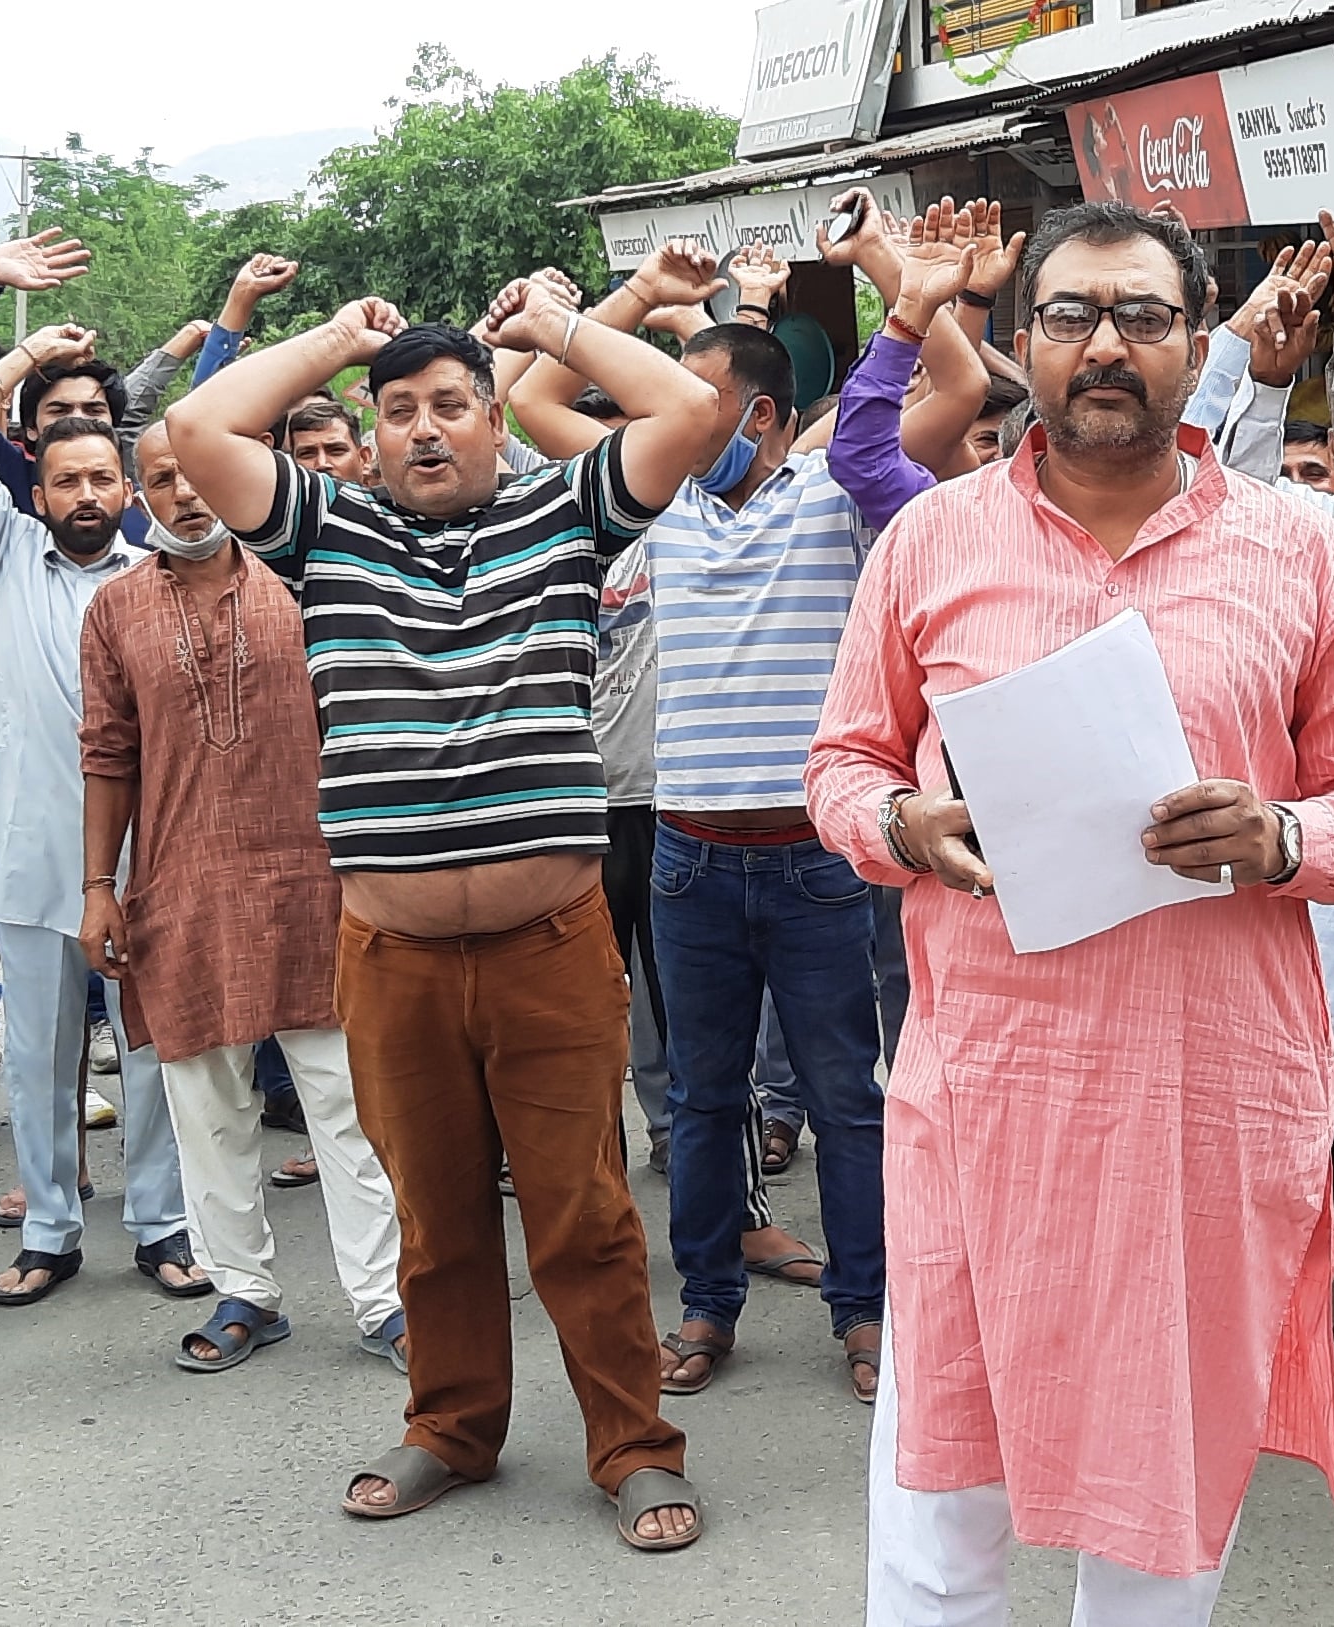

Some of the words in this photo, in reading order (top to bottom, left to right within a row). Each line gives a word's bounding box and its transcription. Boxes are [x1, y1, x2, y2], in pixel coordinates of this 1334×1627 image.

[756, 41, 839, 91] VIDEOCON
[1238, 105, 1282, 140] RANYAL
[1140, 115, 1210, 193] Coca-Cola
[1264, 142, 1327, 178] 9596718877
